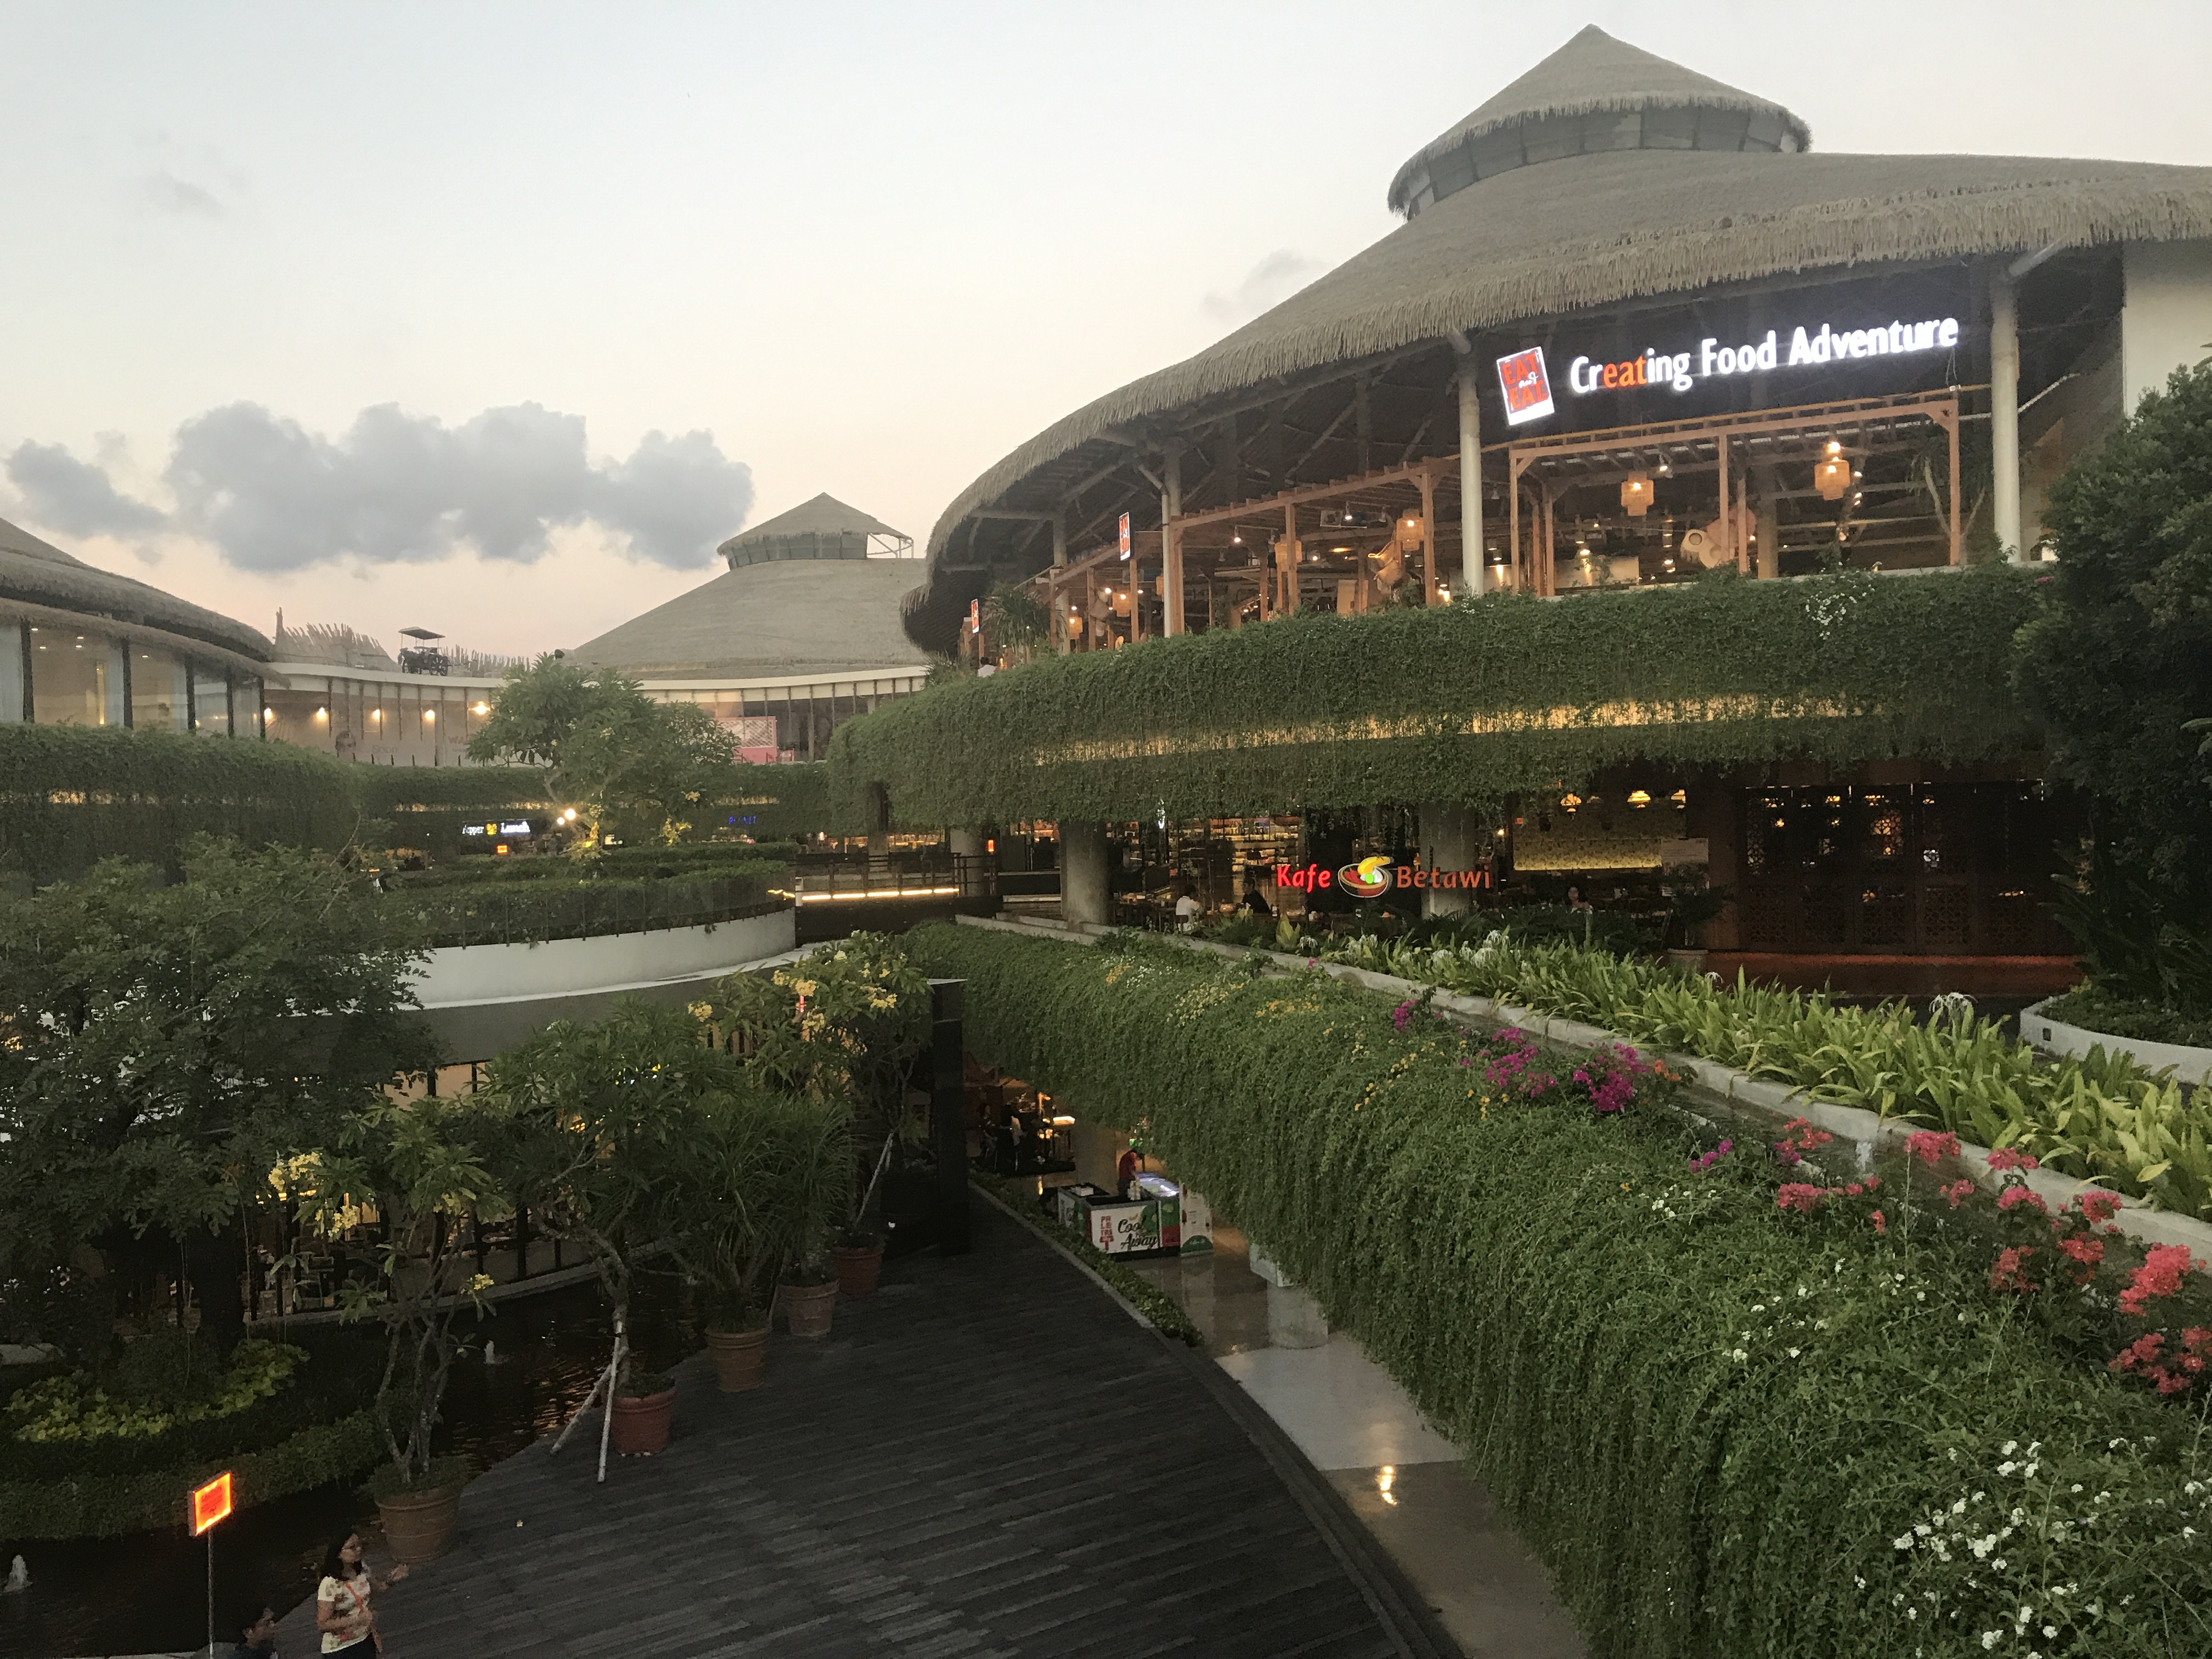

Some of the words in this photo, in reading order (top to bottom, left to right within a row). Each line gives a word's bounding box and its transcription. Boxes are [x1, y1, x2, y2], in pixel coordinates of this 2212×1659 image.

[1502, 353, 1538, 385] EAT
[1571, 348, 1692, 392] Creating
[1702, 330, 1777, 377] Food
[1788, 318, 1959, 365] Adventure
[1509, 380, 1544, 409] EAT
[372, 744, 397, 754] Soon
[1277, 864, 1331, 893] Kafe
[1397, 865, 1490, 888] Betawi
[1120, 1233, 1158, 1250] Away
